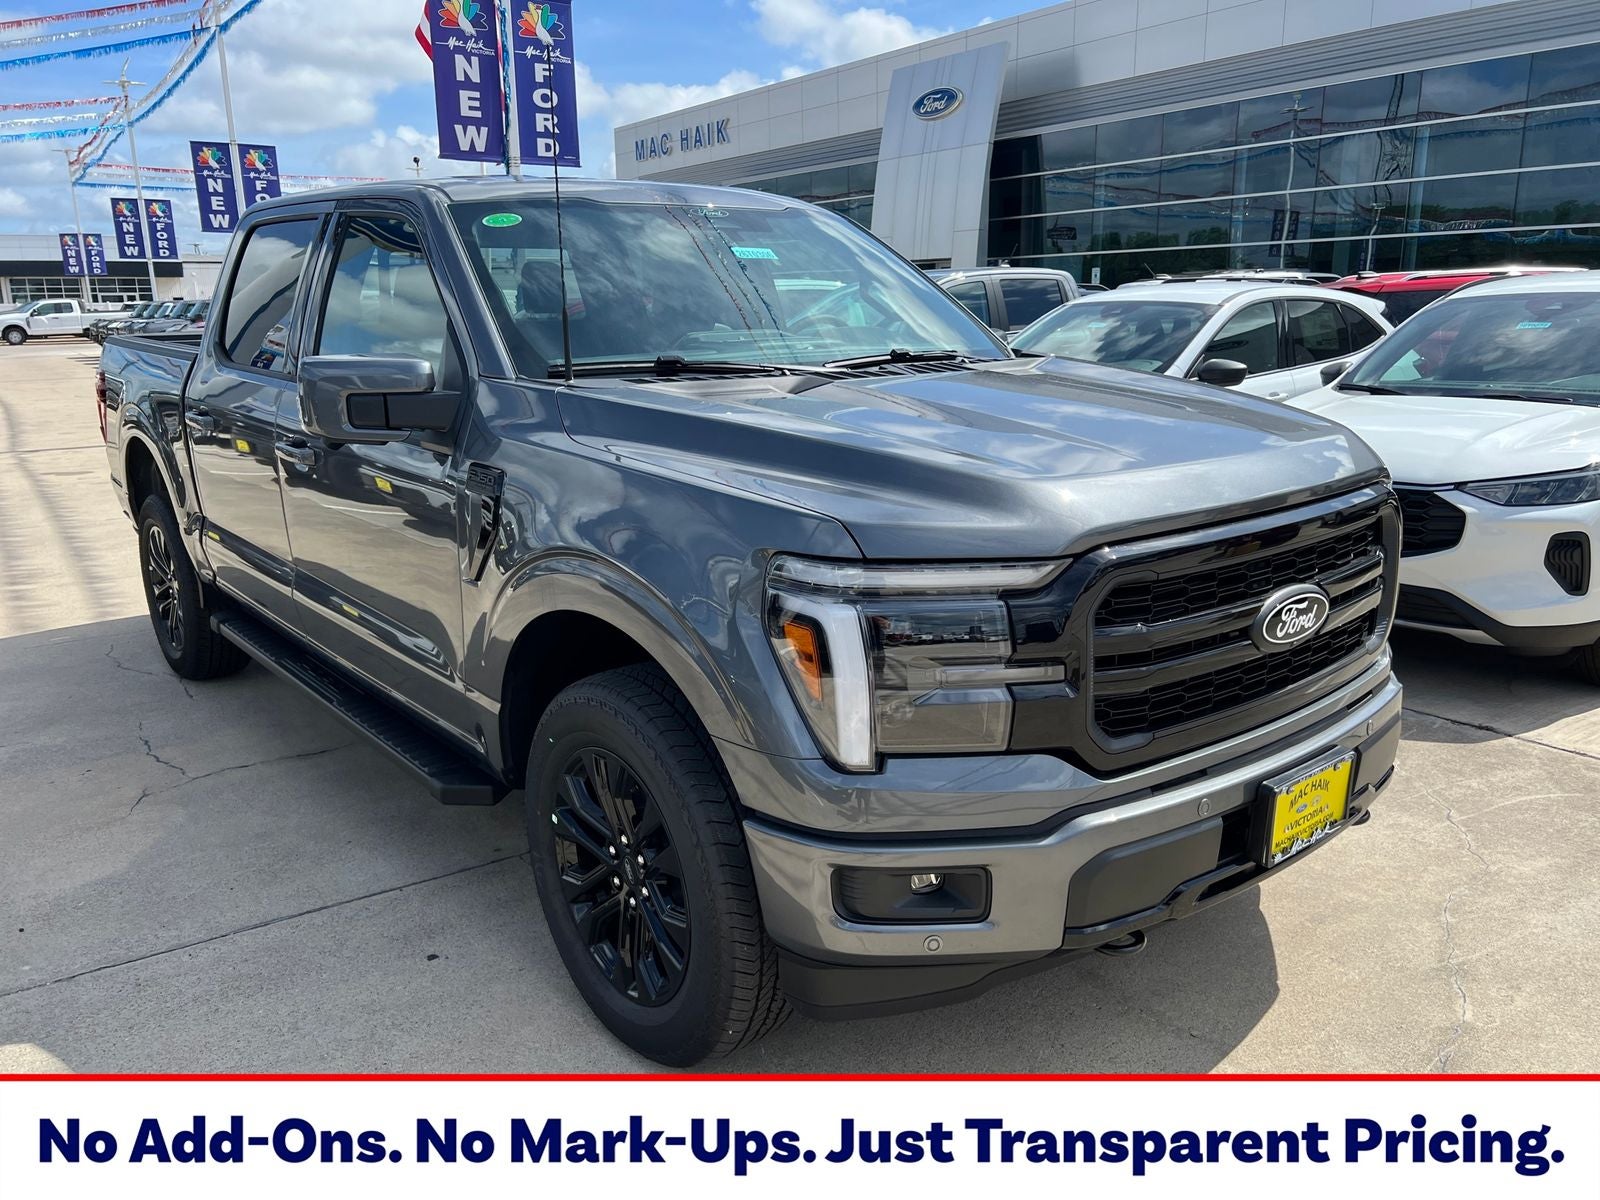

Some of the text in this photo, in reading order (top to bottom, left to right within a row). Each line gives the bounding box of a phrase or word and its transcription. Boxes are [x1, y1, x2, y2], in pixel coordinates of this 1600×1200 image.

[436, 36, 495, 52] Mac Haik
[515, 46, 542, 59] Mac
[454, 54, 488, 153] NEW
[532, 62, 560, 157] FORD
[920, 93, 948, 114] Ford
[635, 118, 727, 161] MAC HAIK
[207, 178, 229, 228] NEW
[255, 180, 271, 203] FO
[122, 222, 138, 256] NEW
[156, 223, 170, 257] FORD
[67, 249, 79, 273] NEW
[91, 250, 101, 274] FORD
[1276, 601, 1318, 638] Ford
[1288, 783, 1310, 812] MAC
[1310, 778, 1330, 792] HAIK
[1289, 806, 1323, 831] VICTORIA
